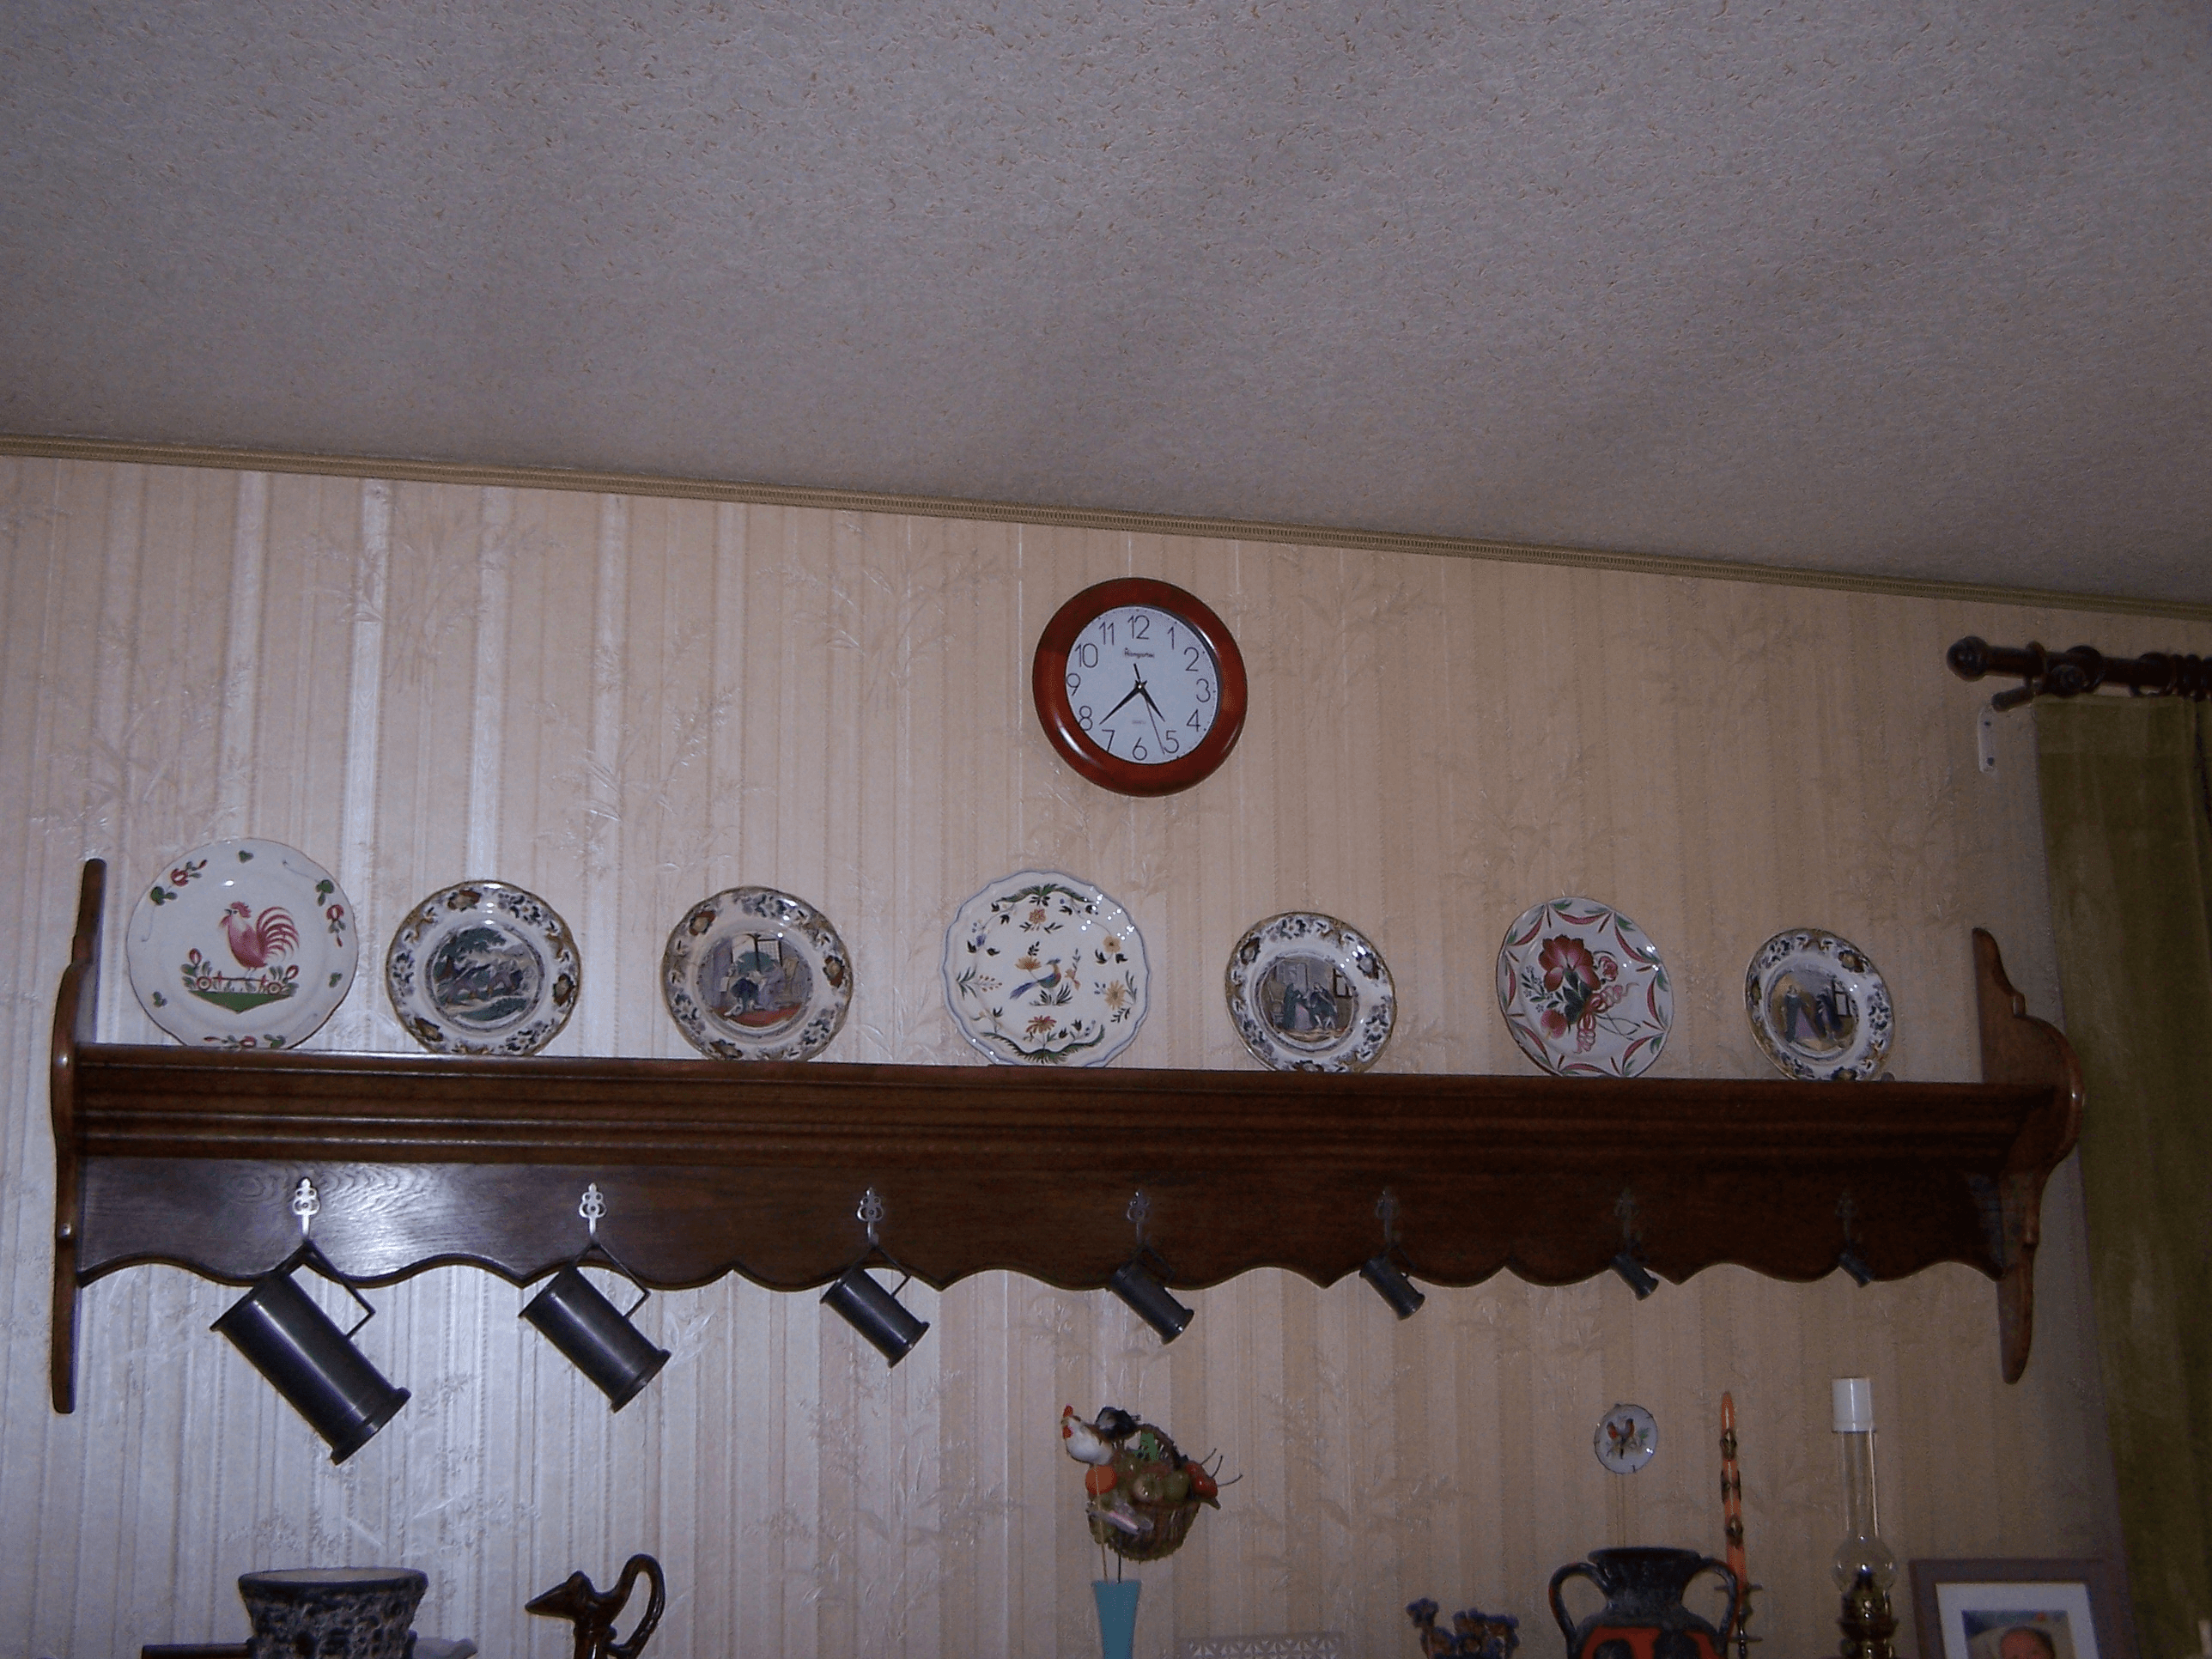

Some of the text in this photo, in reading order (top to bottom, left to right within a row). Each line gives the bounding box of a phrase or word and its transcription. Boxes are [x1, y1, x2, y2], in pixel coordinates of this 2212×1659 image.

[1099, 622, 1115, 645] 11
[1127, 615, 1150, 640] 12
[1167, 627, 1175, 650] 1
[1074, 643, 1098, 667] 10
[1183, 647, 1200, 672] 2
[1066, 673, 1081, 696] 9
[1195, 678, 1211, 702] 3
[1079, 706, 1093, 731] 8
[1186, 708, 1201, 732] 4
[1102, 729, 1115, 752] 7
[1132, 737, 1147, 761] 6
[1164, 730, 1179, 753] 5
